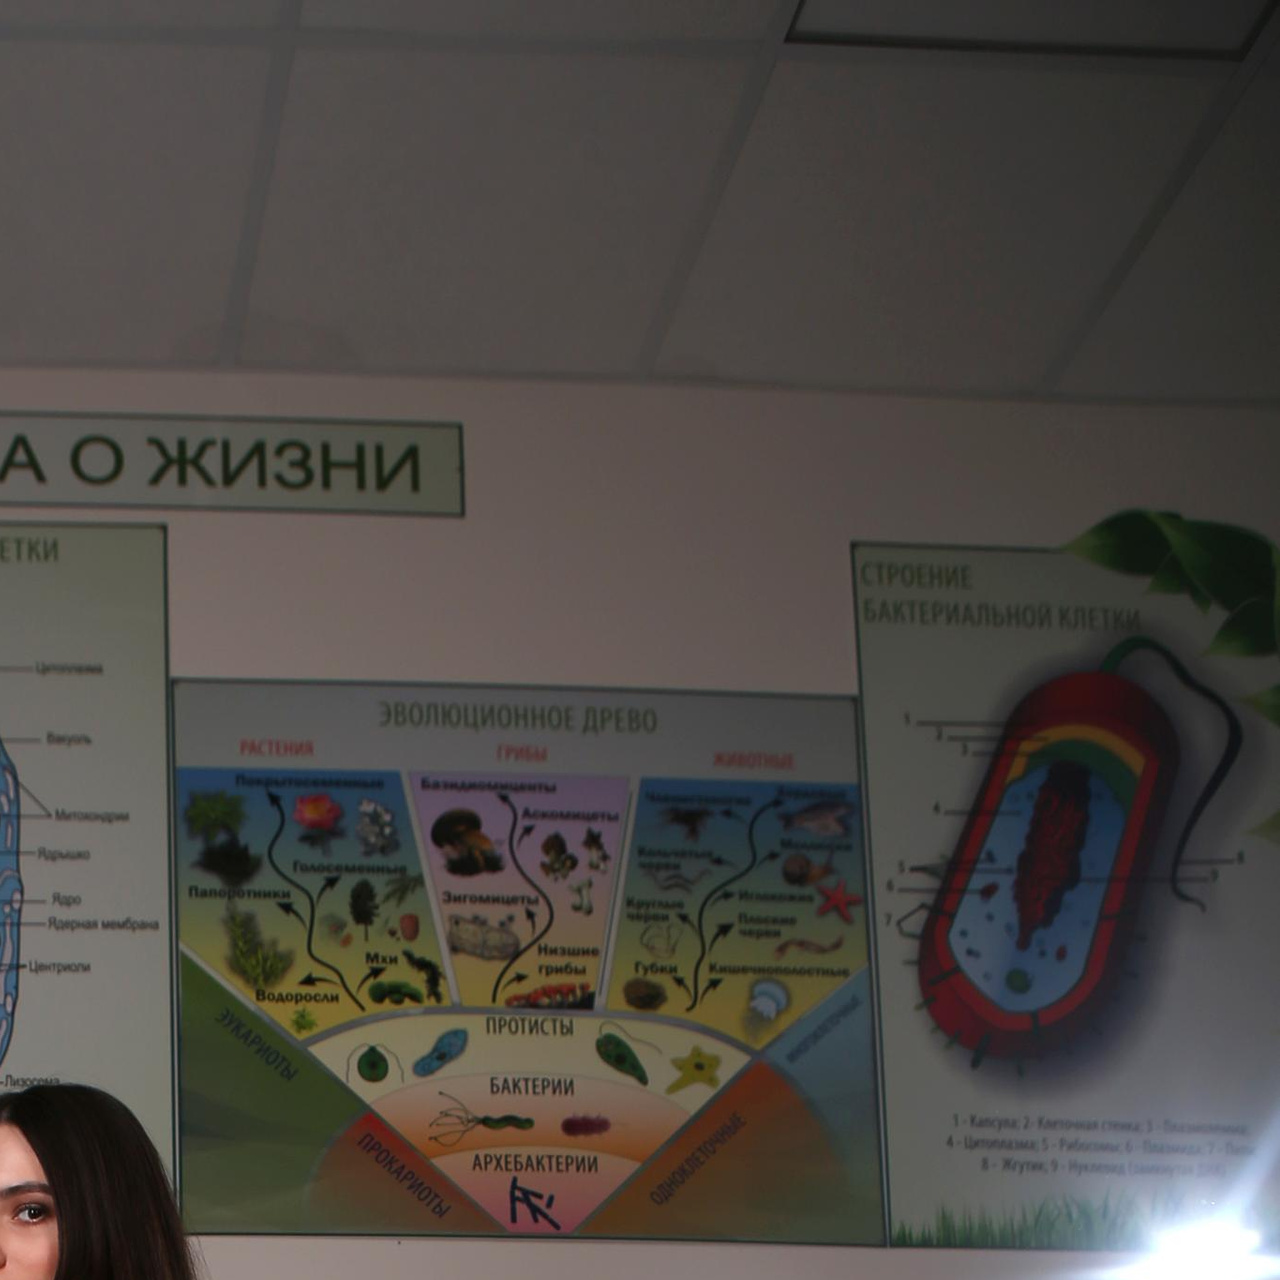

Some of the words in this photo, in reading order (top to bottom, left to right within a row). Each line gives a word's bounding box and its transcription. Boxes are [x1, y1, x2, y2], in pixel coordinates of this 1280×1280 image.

[69, 432, 126, 487] О
[146, 435, 421, 495] ЖИЗНИ
[860, 560, 973, 591] СТРОЕНИЕ
[863, 597, 1053, 630] БАКТЕРИАЛЬНОЙ
[1058, 604, 1142, 632] КЛЕТКИ
[378, 700, 577, 733] ЭВОЛЮЦИОННОЕ
[581, 705, 658, 736] ДРЕВО
[239, 738, 315, 758] РАСТЕНИЯ
[496, 743, 549, 763] ГРИБЫ
[521, 806, 620, 823] Аскомицеты
[292, 860, 408, 877] Голосеменные
[187, 884, 292, 902] Папоротники
[441, 889, 540, 907] Зигомицеты
[47, 916, 99, 933] Ядерная
[100, 915, 161, 933] мембрана
[28, 960, 92, 977] Центриоли
[365, 951, 400, 967] Мхи
[633, 961, 679, 977] Губки
[537, 962, 588, 978] грибы
[708, 962, 851, 978] Кишечнополостные
[254, 987, 341, 1005] Водоросли
[485, 1015, 574, 1037] ПРОТИСТЫ
[214, 1006, 300, 1084] ЭУКАРИОТЫ
[489, 1075, 576, 1098] БАКТЕРИИ
[472, 1152, 600, 1175] АРХЕБАКТЕРИИ
[649, 1109, 749, 1209] ОДНОКЛЕТОЧНЫЕ
[356, 1132, 453, 1220] ПРОКАРИОТЫ
